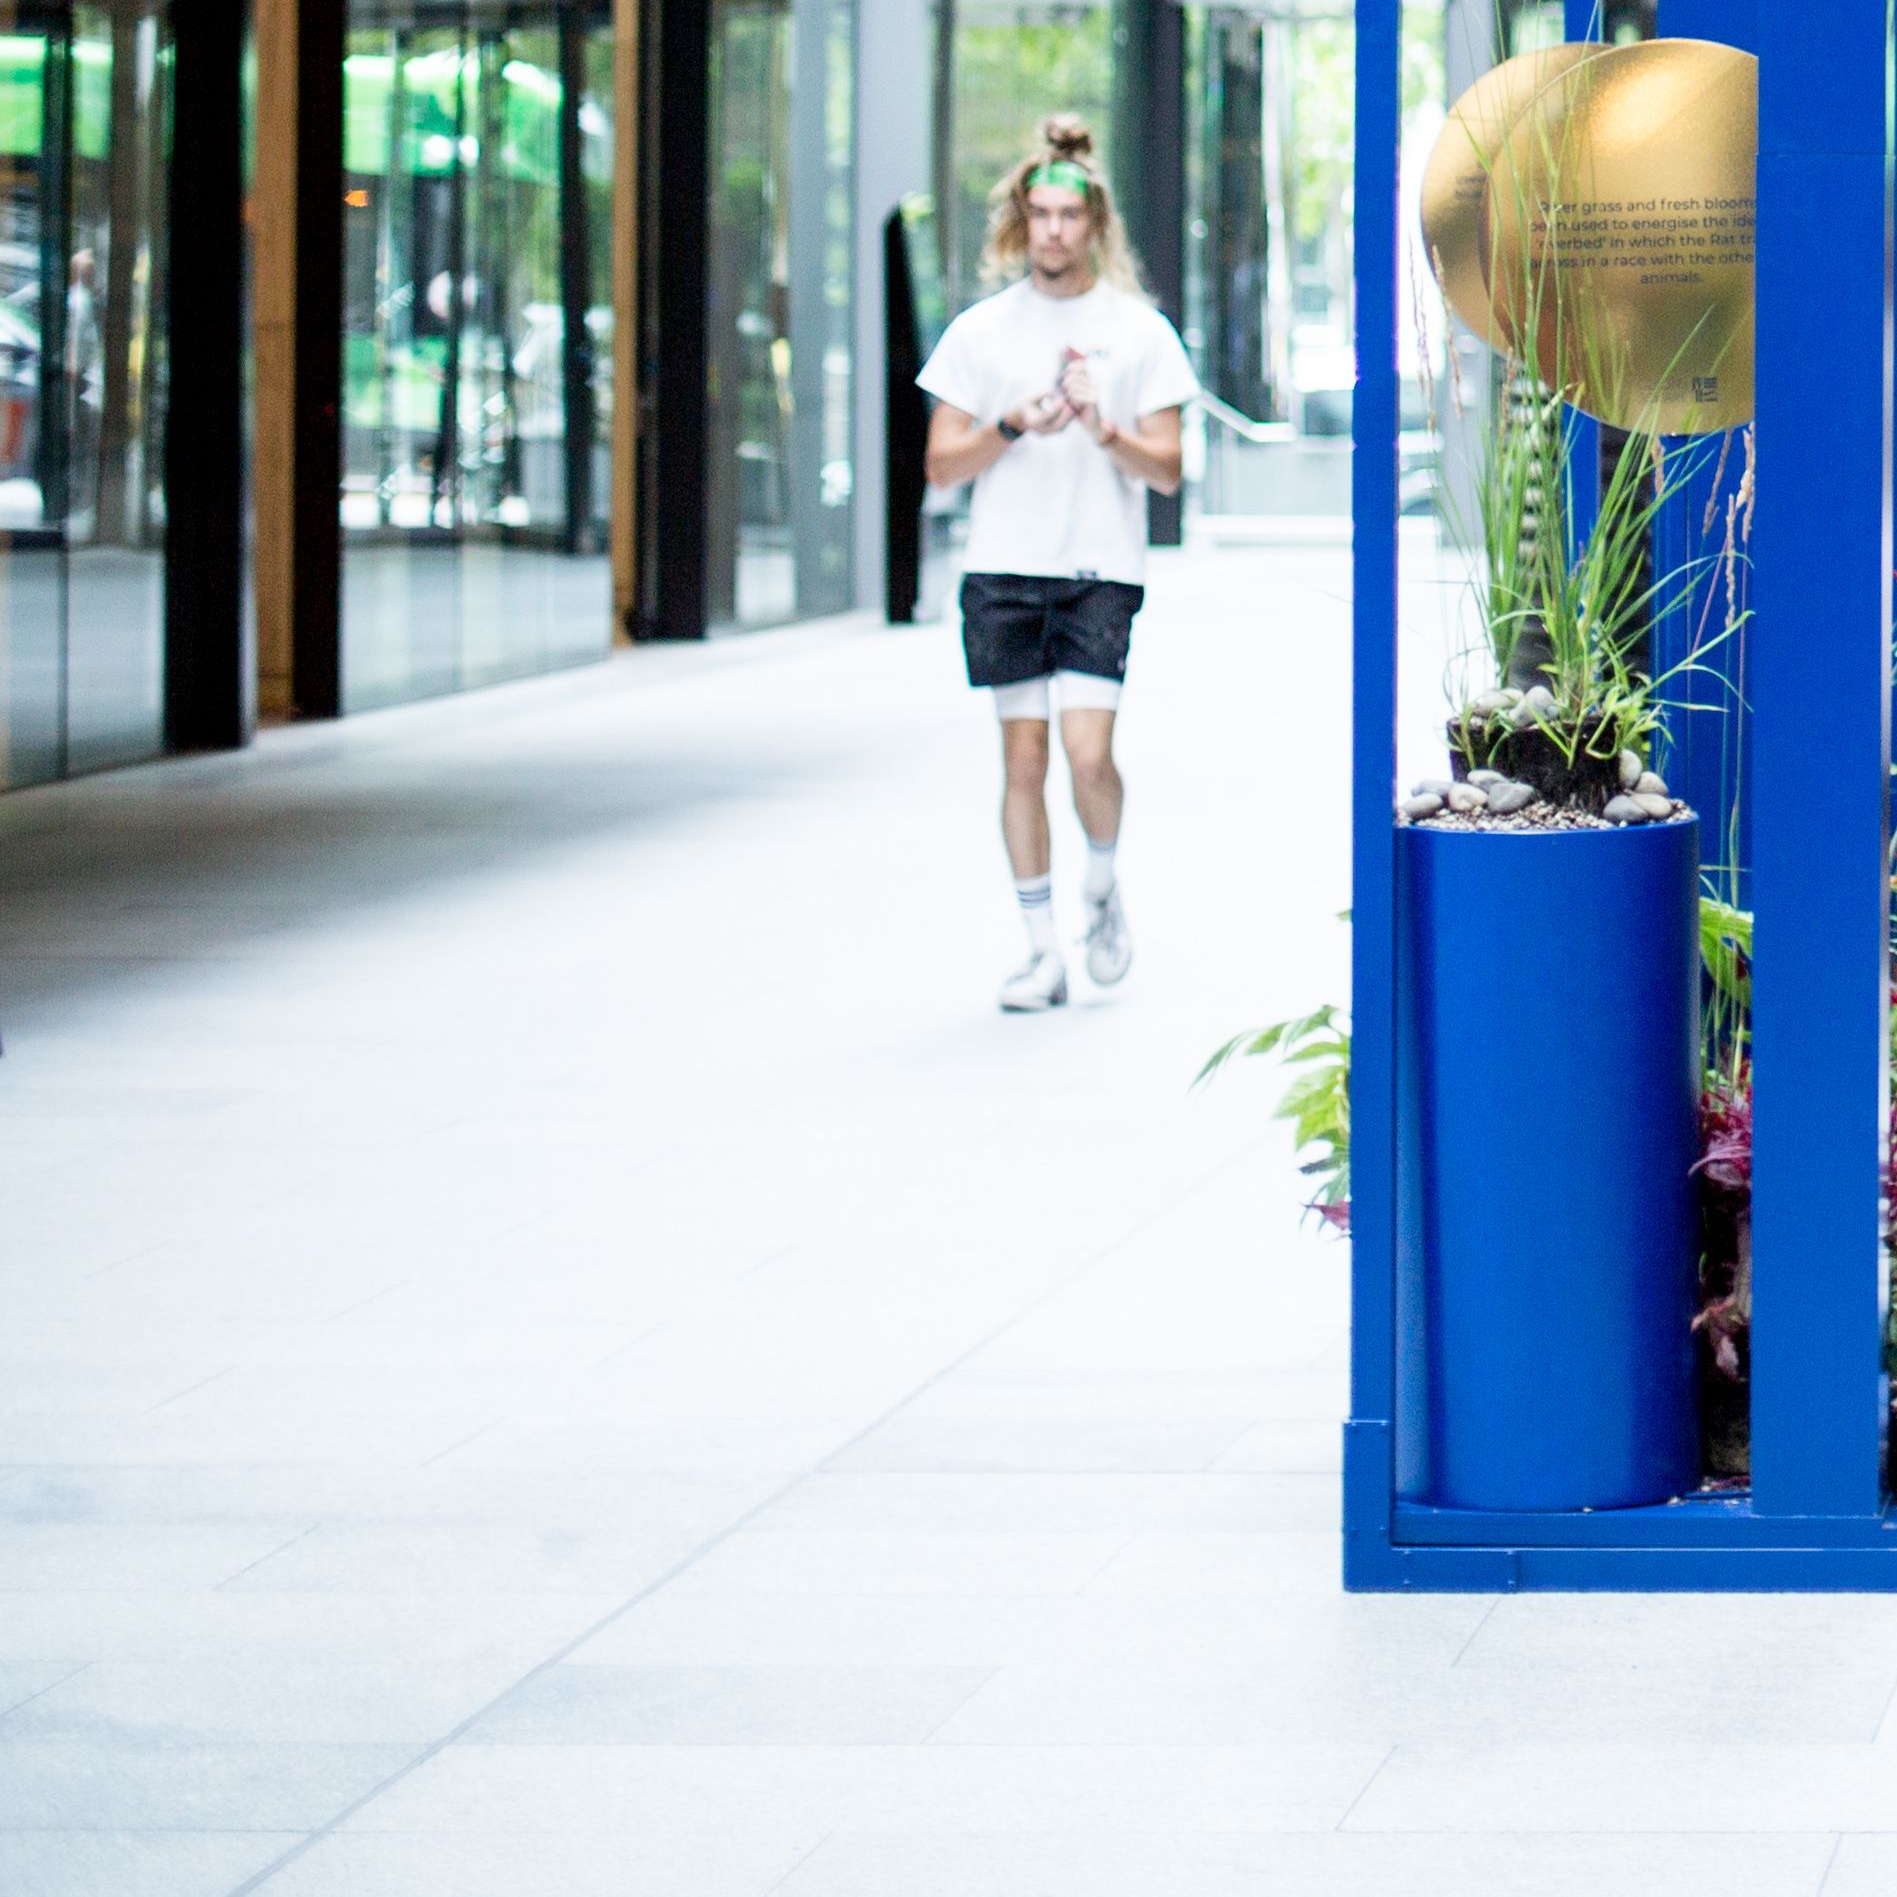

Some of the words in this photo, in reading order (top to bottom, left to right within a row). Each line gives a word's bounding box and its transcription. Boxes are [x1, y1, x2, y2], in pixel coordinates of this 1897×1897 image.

[1581, 201, 1623, 216] grass
[1626, 198, 1656, 213] and
[1660, 197, 1700, 212] fresh
[1703, 196, 1756, 211] bloom
[1571, 217, 1608, 232] used
[1612, 217, 1629, 231] to
[1631, 215, 1698, 233] energise
[1702, 215, 1729, 229] the
[1609, 236, 1625, 250] in
[1629, 234, 1677, 250] which
[1679, 233, 1705, 248] the
[1710, 232, 1736, 246] Rat
[1581, 254, 1597, 268] in
[1599, 256, 1609, 268] a
[1613, 254, 1647, 267] race
[1650, 252, 1685, 266] with
[1688, 250, 1714, 265] the
[1718, 249, 1755, 264] othe
